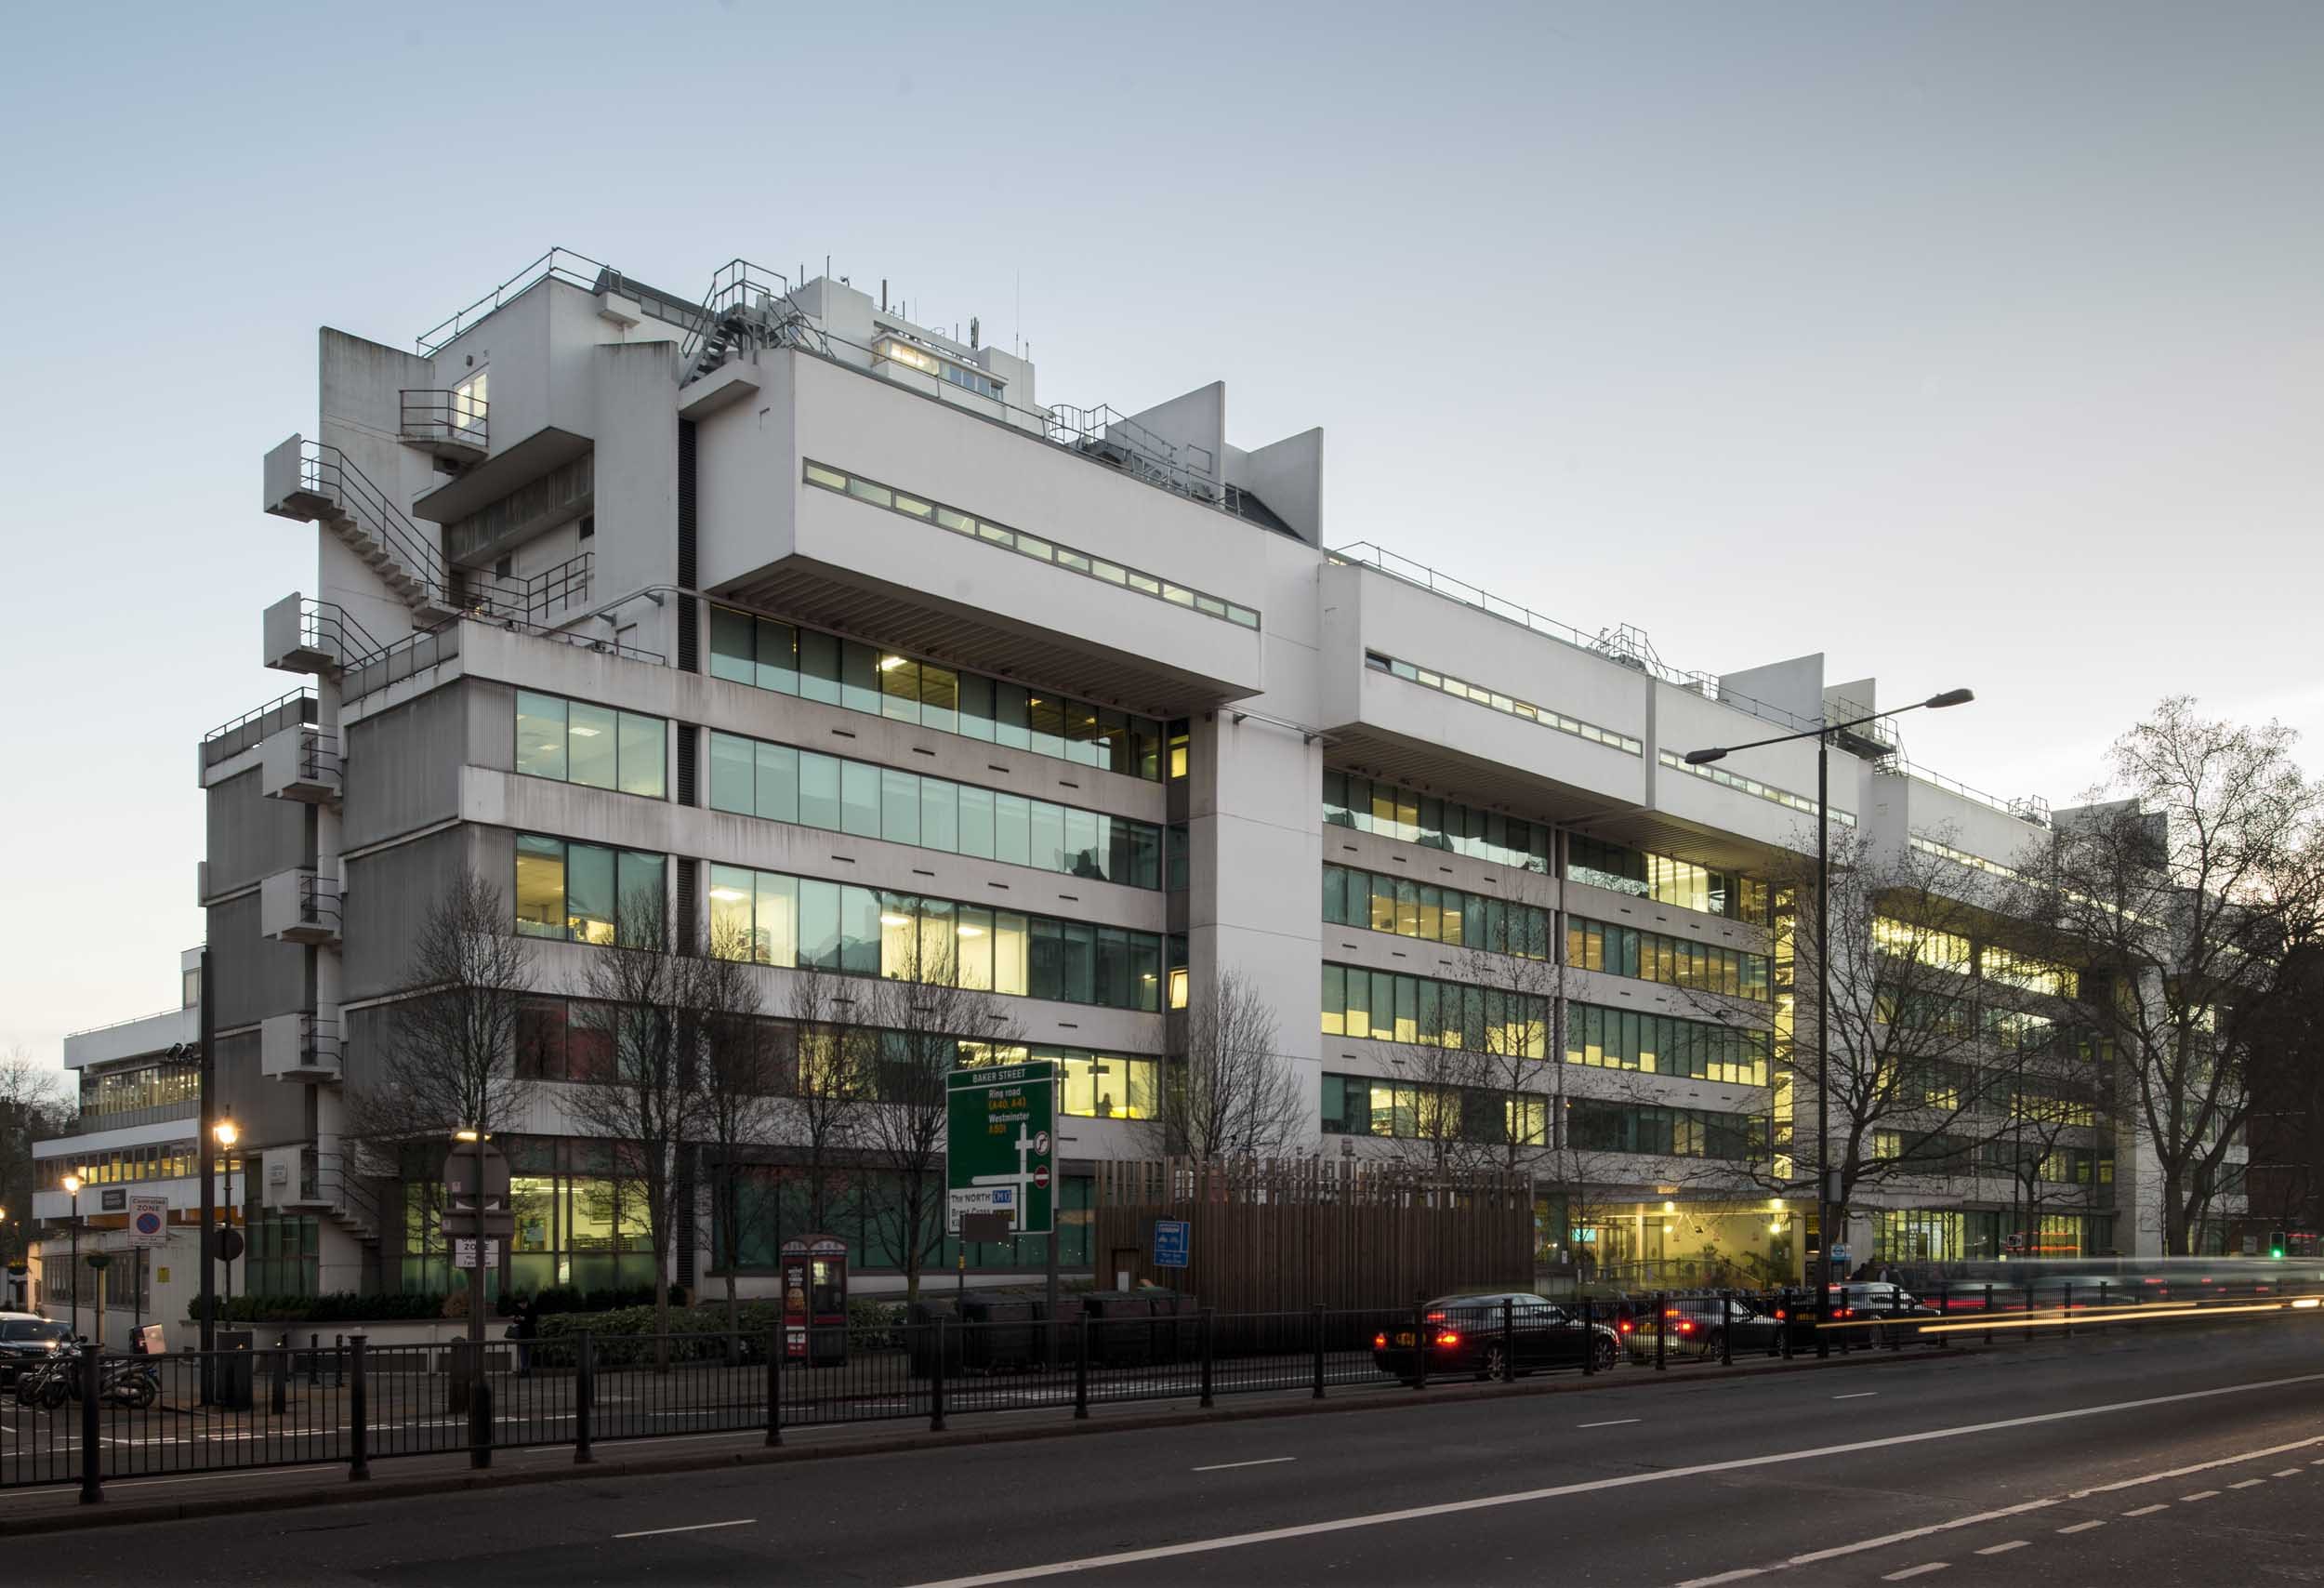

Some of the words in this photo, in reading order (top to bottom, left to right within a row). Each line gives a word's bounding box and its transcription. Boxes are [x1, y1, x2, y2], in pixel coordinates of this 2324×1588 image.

[972, 1073, 997, 1084] BAKER
[998, 1069, 1026, 1080] STREET
[988, 1090, 1004, 1099] Ring
[1005, 1088, 1022, 1097] road
[988, 1112, 1030, 1124] Westminster
[951, 1195, 963, 1203] The
[965, 1193, 991, 1203] NORTH
